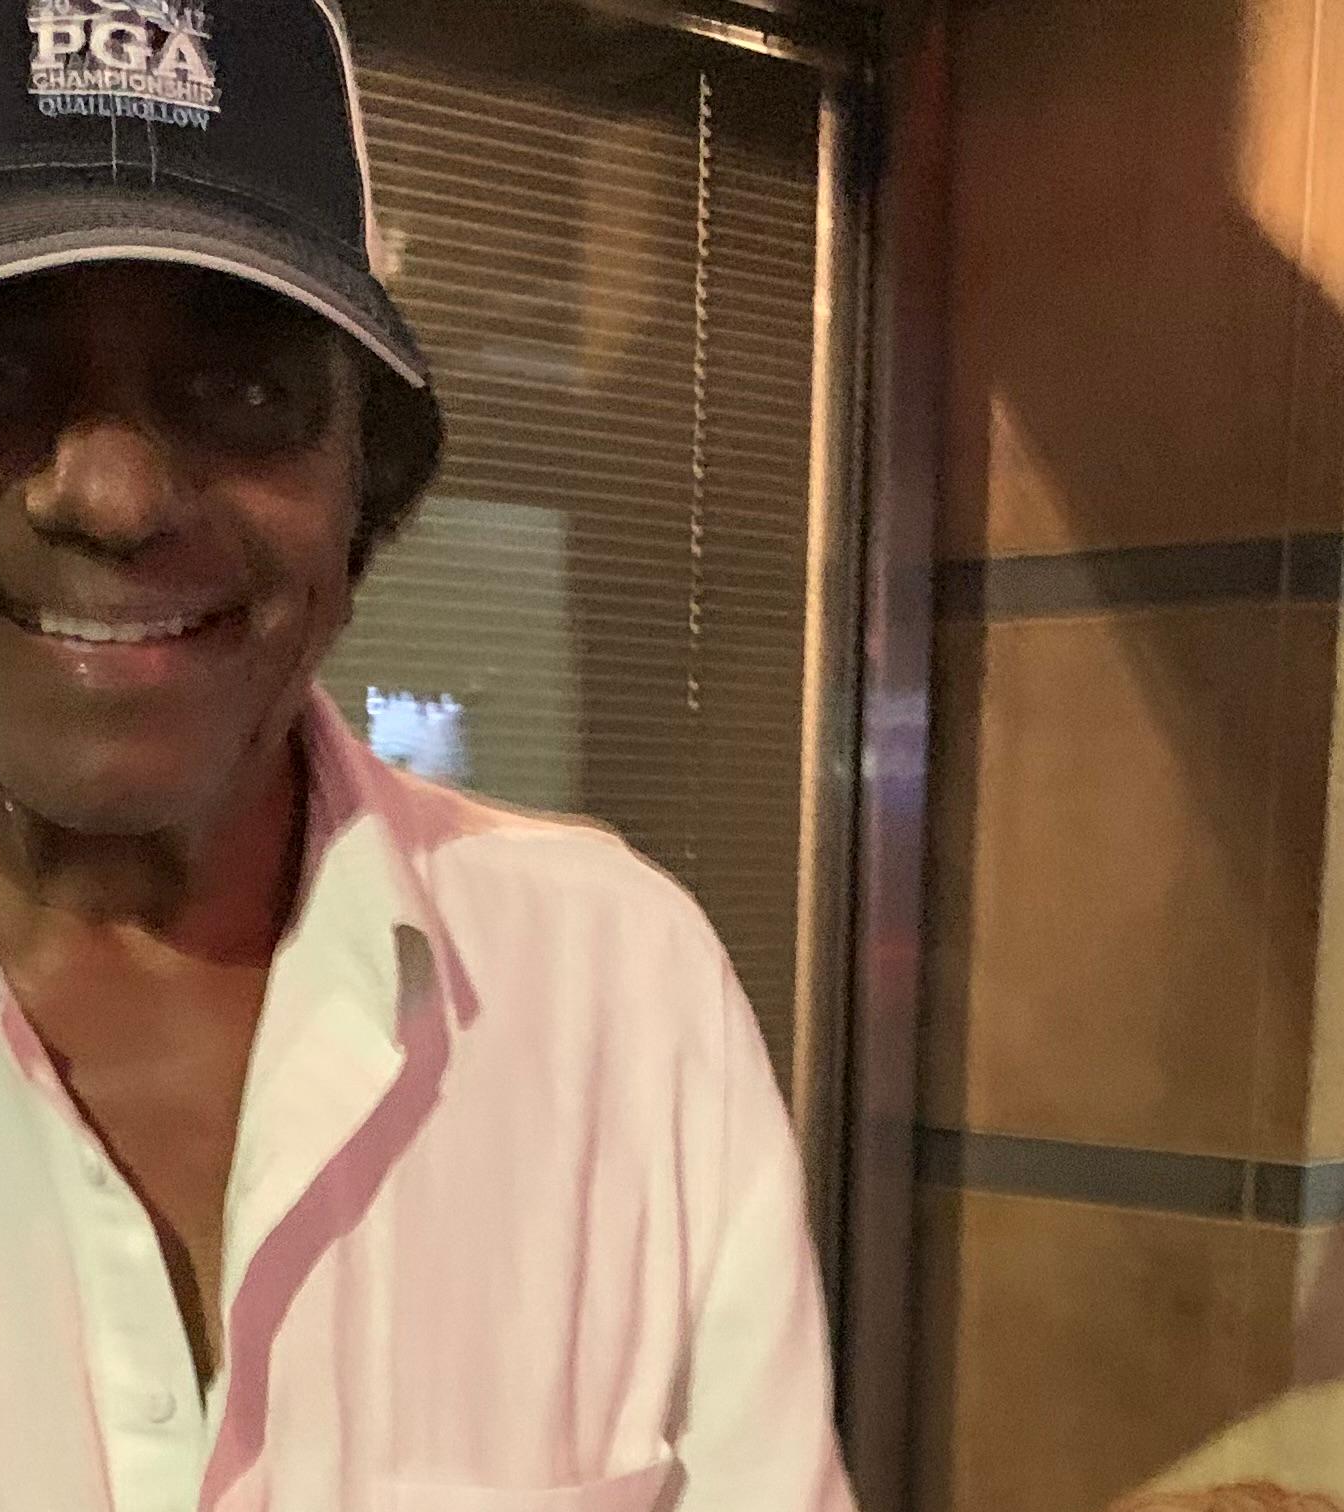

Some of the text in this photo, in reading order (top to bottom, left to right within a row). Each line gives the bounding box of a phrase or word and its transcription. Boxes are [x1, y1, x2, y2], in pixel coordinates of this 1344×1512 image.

[29, 18, 216, 87] PGA
[38, 95, 211, 131] QUAIL HOLLOW
